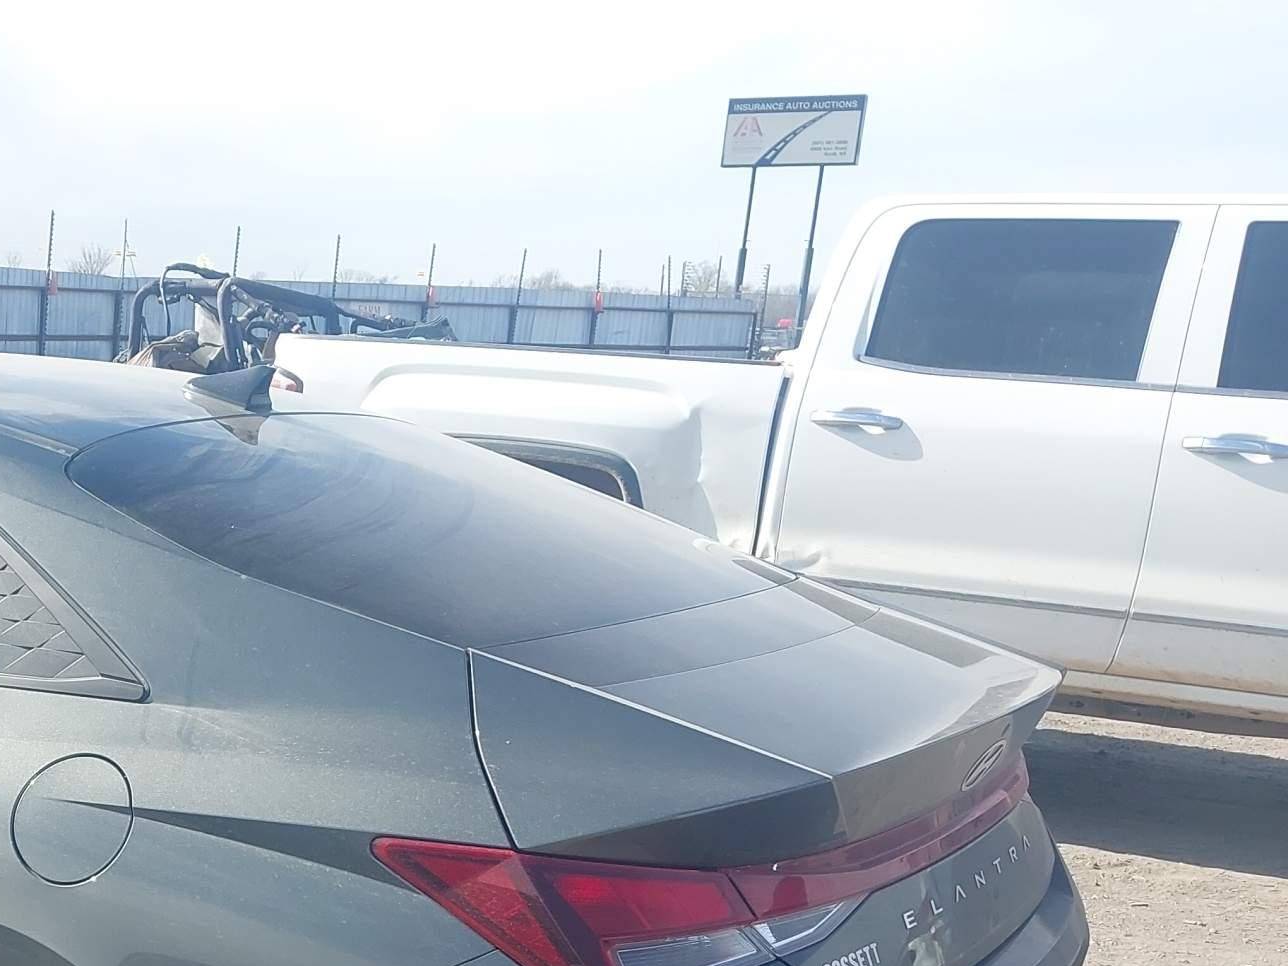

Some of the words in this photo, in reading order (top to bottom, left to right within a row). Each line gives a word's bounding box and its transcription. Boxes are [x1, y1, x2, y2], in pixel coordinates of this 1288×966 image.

[733, 102, 784, 111] INSURANCE
[786, 101, 810, 110] AUTO
[812, 100, 858, 109] AUCTIONS
[903, 835, 1031, 929] ELANTRA
